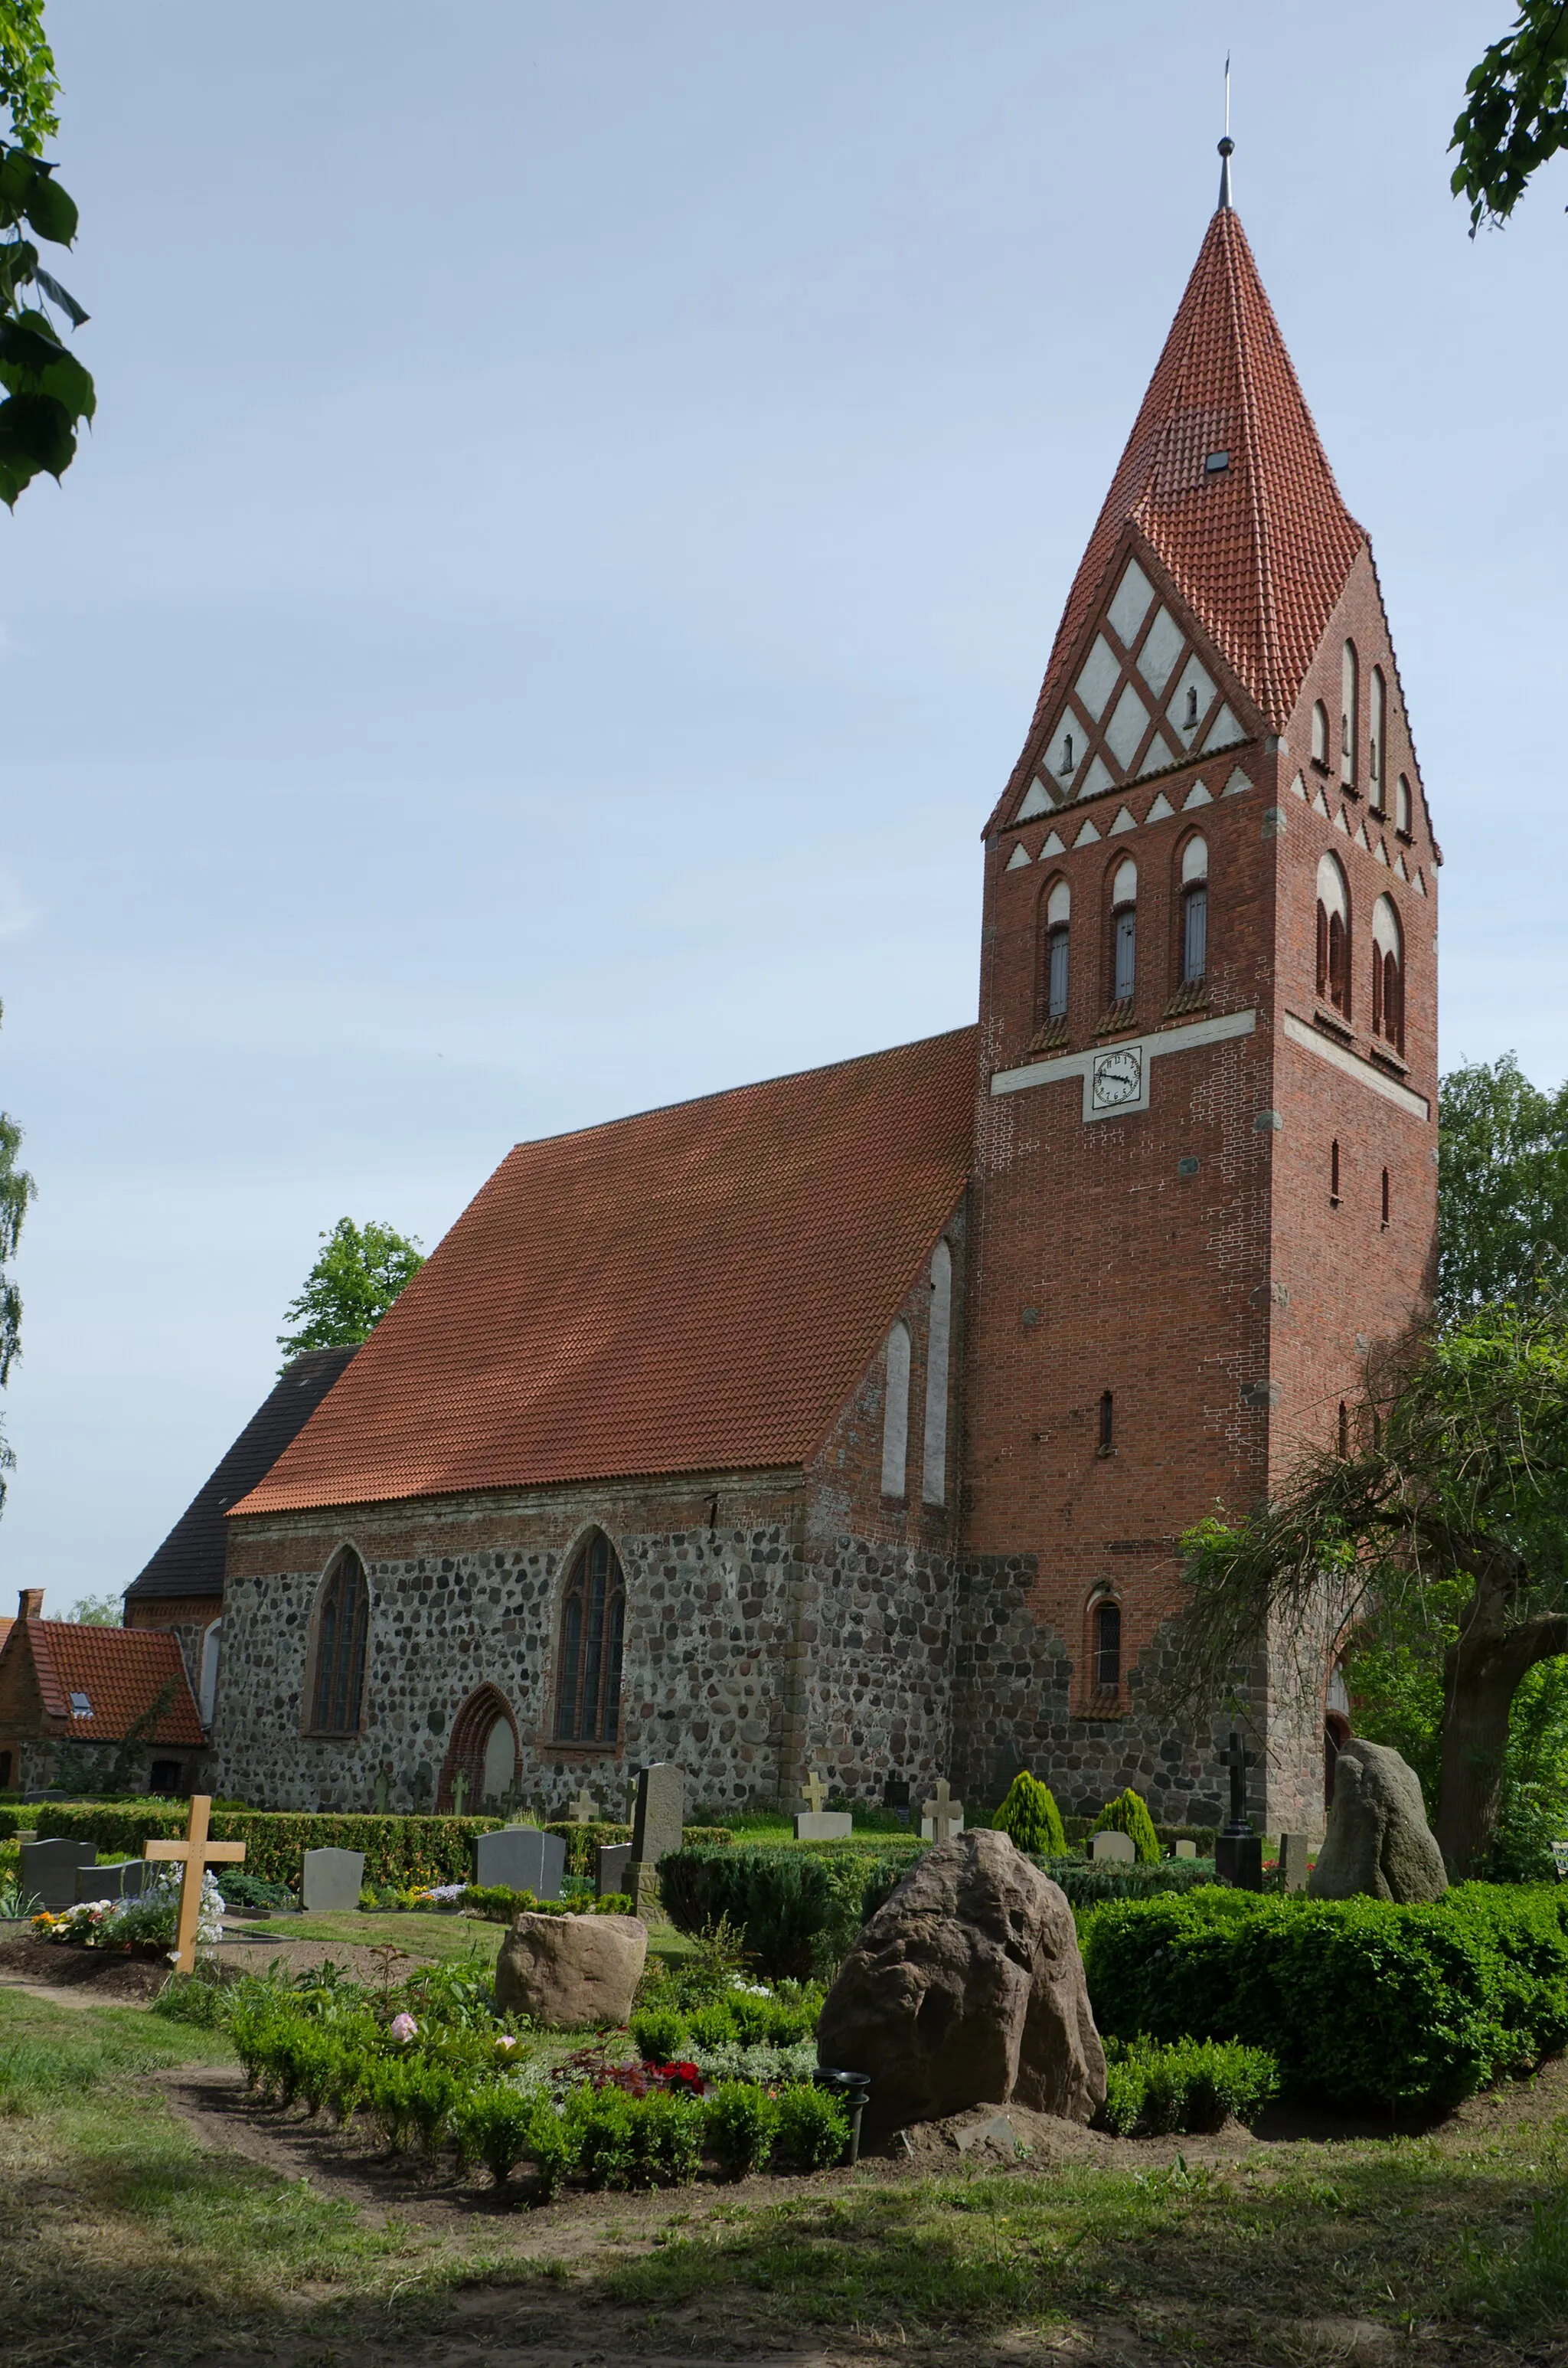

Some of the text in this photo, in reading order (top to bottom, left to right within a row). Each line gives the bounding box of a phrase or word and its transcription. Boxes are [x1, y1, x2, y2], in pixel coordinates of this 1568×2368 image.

[1106, 1060, 1112, 1069] 11
[1114, 1055, 1121, 1065] 12
[1124, 1056, 1127, 1065] 1
[1130, 1060, 1135, 1069] 2
[1114, 1091, 1119, 1100] 6
